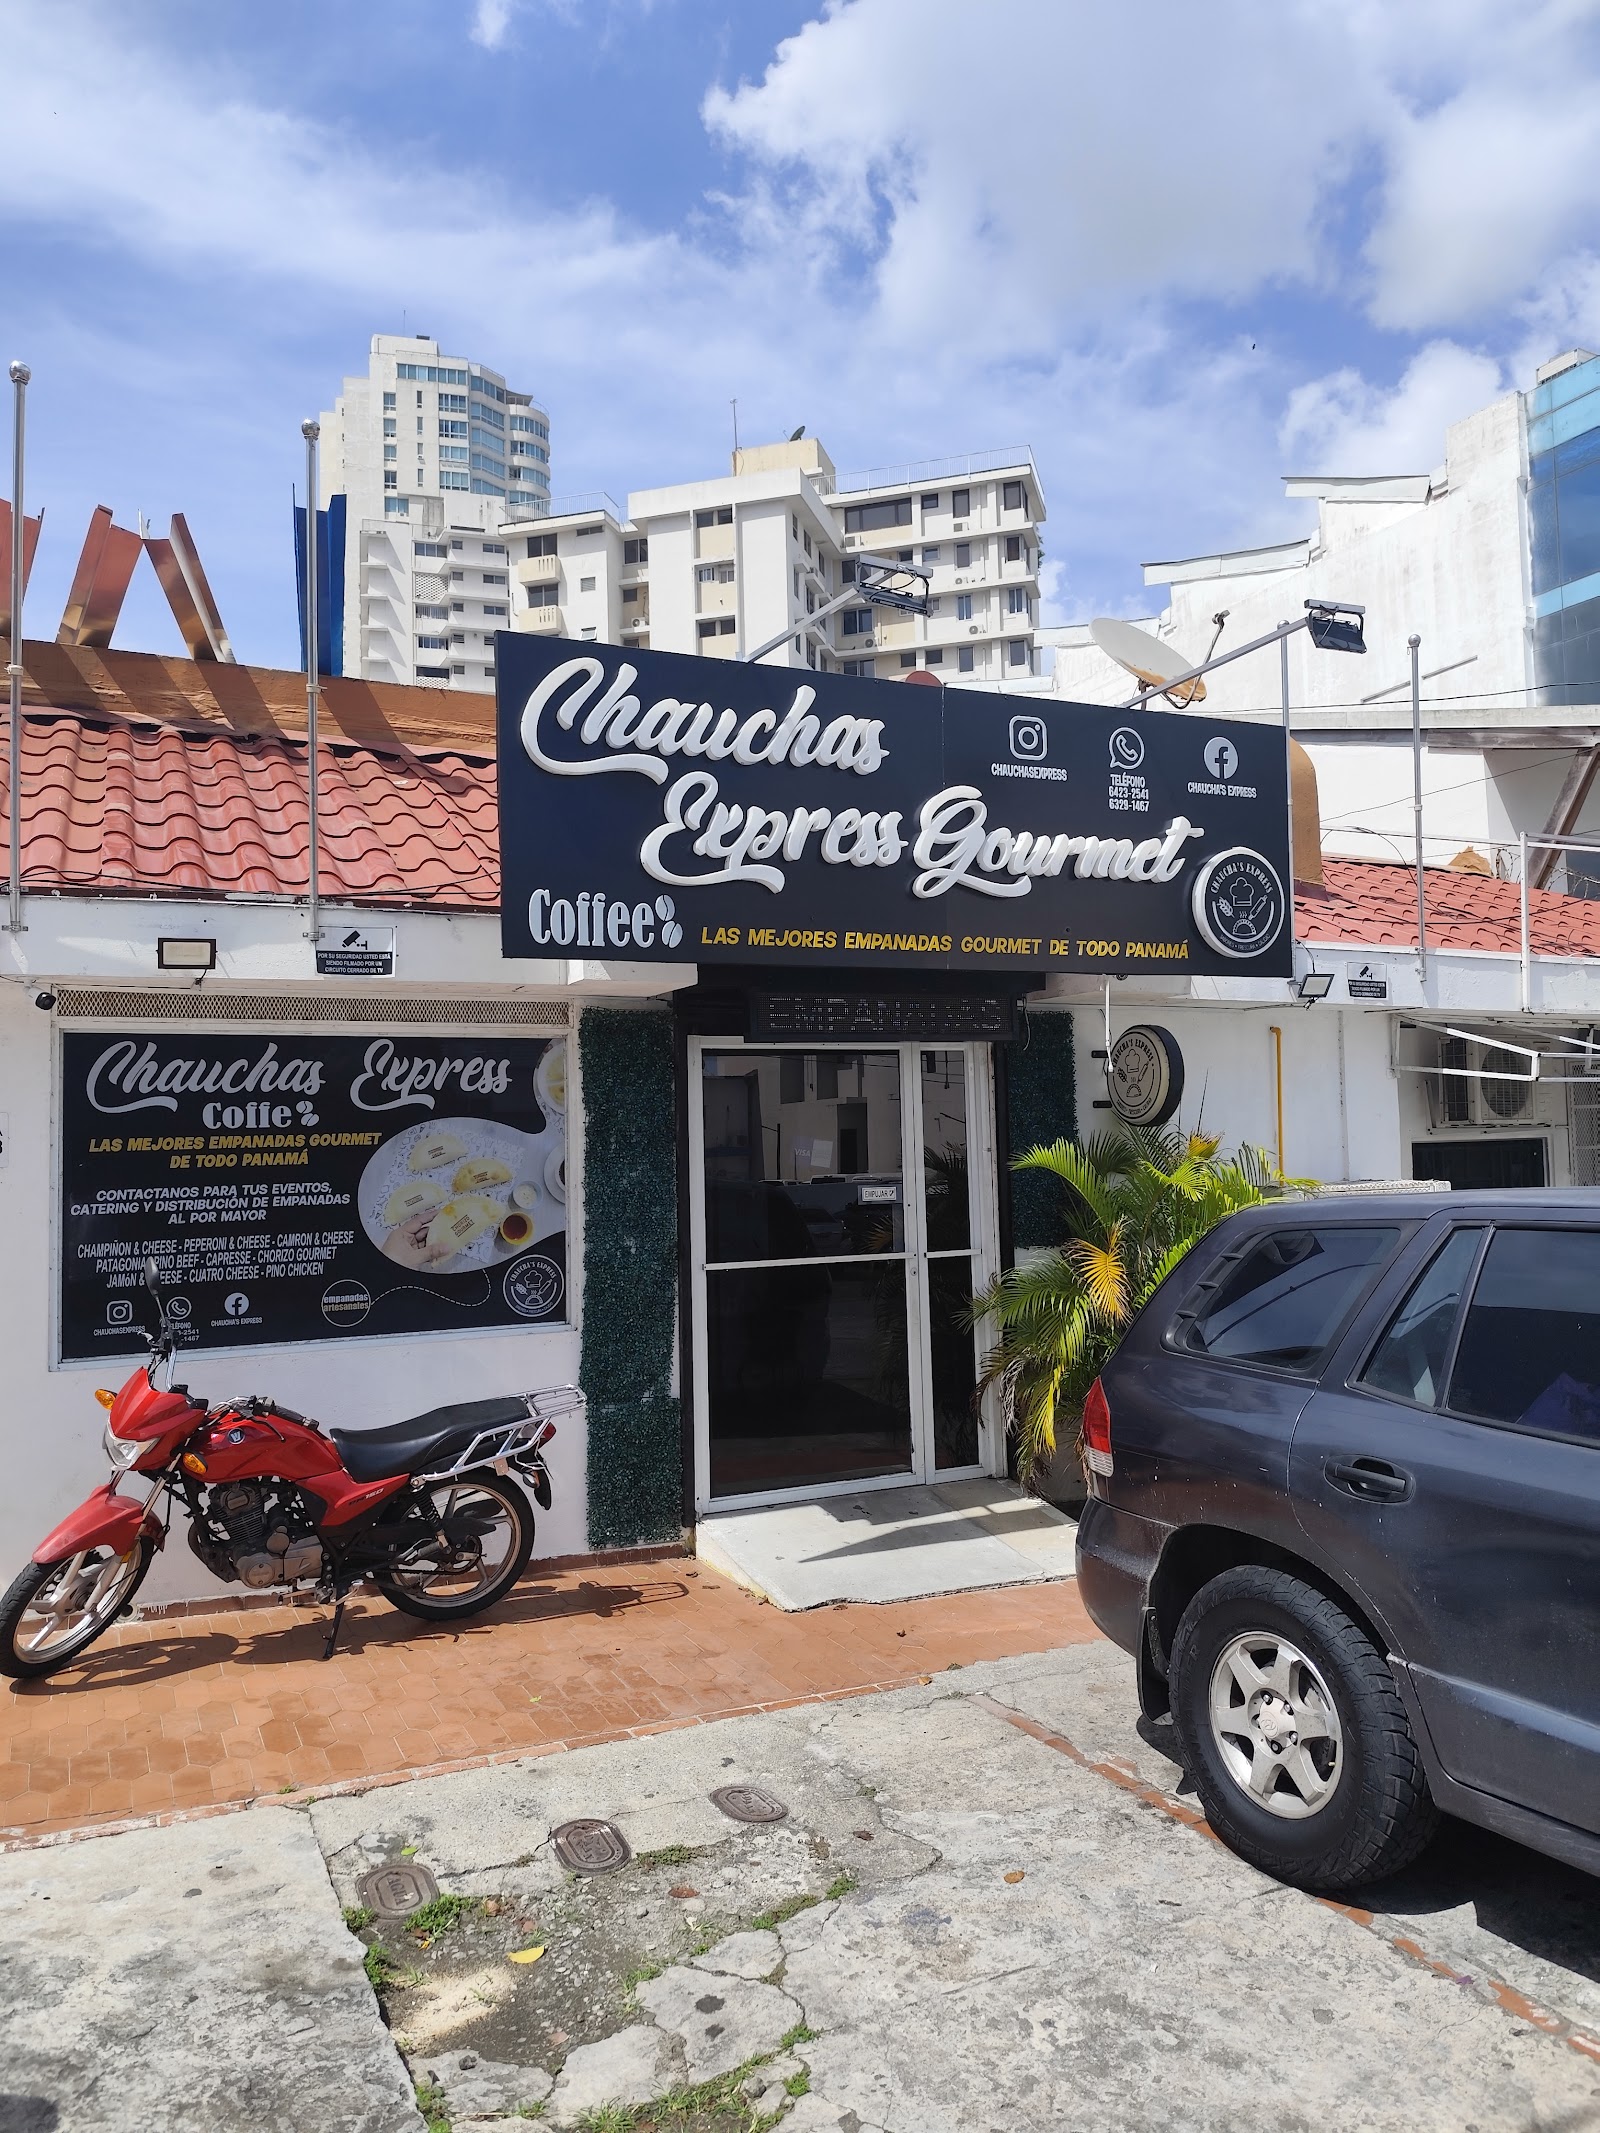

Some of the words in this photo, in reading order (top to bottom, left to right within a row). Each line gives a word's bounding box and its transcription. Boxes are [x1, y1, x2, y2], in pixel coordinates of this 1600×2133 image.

[520, 657, 889, 784] Chauchas
[991, 763, 1067, 781] CHAUCHASEXPRESS
[1110, 772, 1146, 788] TELÉFONO
[1109, 787, 1149, 800] 6423-2541
[1188, 782, 1226, 797] CHAUCHA'S
[1227, 785, 1257, 799] EXPRESS
[1109, 799, 1149, 812] 6329-1467
[640, 770, 908, 894] Express
[912, 785, 1204, 898] Gourmet
[1210, 861, 1245, 894] CHAUCHA'S
[1245, 862, 1273, 894] EXPRESS
[528, 888, 655, 948] Coffee
[701, 926, 740, 945] LAS
[748, 928, 837, 949] MEJORES
[844, 931, 952, 952] EMPANADAS
[960, 936, 1042, 955] GOURMET
[1049, 939, 1069, 956] DE
[1076, 940, 1120, 957] TODO
[1125, 939, 1189, 959] PANAMÁ
[86, 1040, 327, 1114] Chauchas
[350, 1038, 512, 1111] Express
[202, 1101, 292, 1130] Coffe
[89, 1138, 123, 1152] LAS
[127, 1136, 204, 1151] MEJORES
[209, 1134, 305, 1150] EMPANADAS
[309, 1132, 382, 1148] GOURMET
[170, 1155, 191, 1169] DE
[195, 1154, 237, 1168] TODO
[242, 1148, 309, 1167] PANAMÁ
[794, 1148, 811, 1157] VISA
[96, 1187, 199, 1202] CONTACTANOS
[203, 1185, 238, 1197] PARA
[242, 1184, 268, 1196] TUS
[271, 1182, 332, 1195] EVENTOS,
[70, 1202, 140, 1216] CATERING
[143, 1201, 153, 1213] Y
[155, 1196, 248, 1212] DISTRIBUCIÓN
[252, 1197, 269, 1209] DE
[272, 1194, 350, 1207] EMPANADAS
[168, 1213, 186, 1225] AL
[189, 1212, 217, 1223] POR
[220, 1209, 266, 1222] MAYOR
[77, 1240, 132, 1259] CHAMPIÑON
[133, 1241, 140, 1255] &
[142, 1239, 178, 1255] CHEESE
[183, 1236, 227, 1252] PEPERONI
[228, 1236, 235, 1250] &
[237, 1234, 271, 1249] CHEESE
[277, 1232, 313, 1247] CAMRON
[314, 1232, 320, 1245] &
[321, 1231, 354, 1245] CHEESE
[96, 1257, 146, 1273] PATAGONIA
[155, 1254, 174, 1270] PINO
[176, 1253, 200, 1268] BEEF
[206, 1250, 251, 1266] CAPRESSE
[257, 1248, 295, 1263] CHORIZO
[296, 1246, 337, 1261] GOURMET
[139, 1272, 145, 1286] &
[160, 1270, 182, 1285] EESE
[189, 1267, 224, 1282] CUATRO
[225, 1265, 260, 1280] CHEESE
[265, 1263, 286, 1278] PINO
[287, 1262, 324, 1276] CHICKEN
[536, 1261, 557, 1279] EXPRESS
[323, 1302, 369, 1311] artesanales
[324, 1293, 368, 1303] empanadas
[93, 1325, 146, 1336] CHAUCHASEXPRESS
[211, 1318, 240, 1327] CHAUCHA'S
[241, 1317, 263, 1325] EXPRESS
